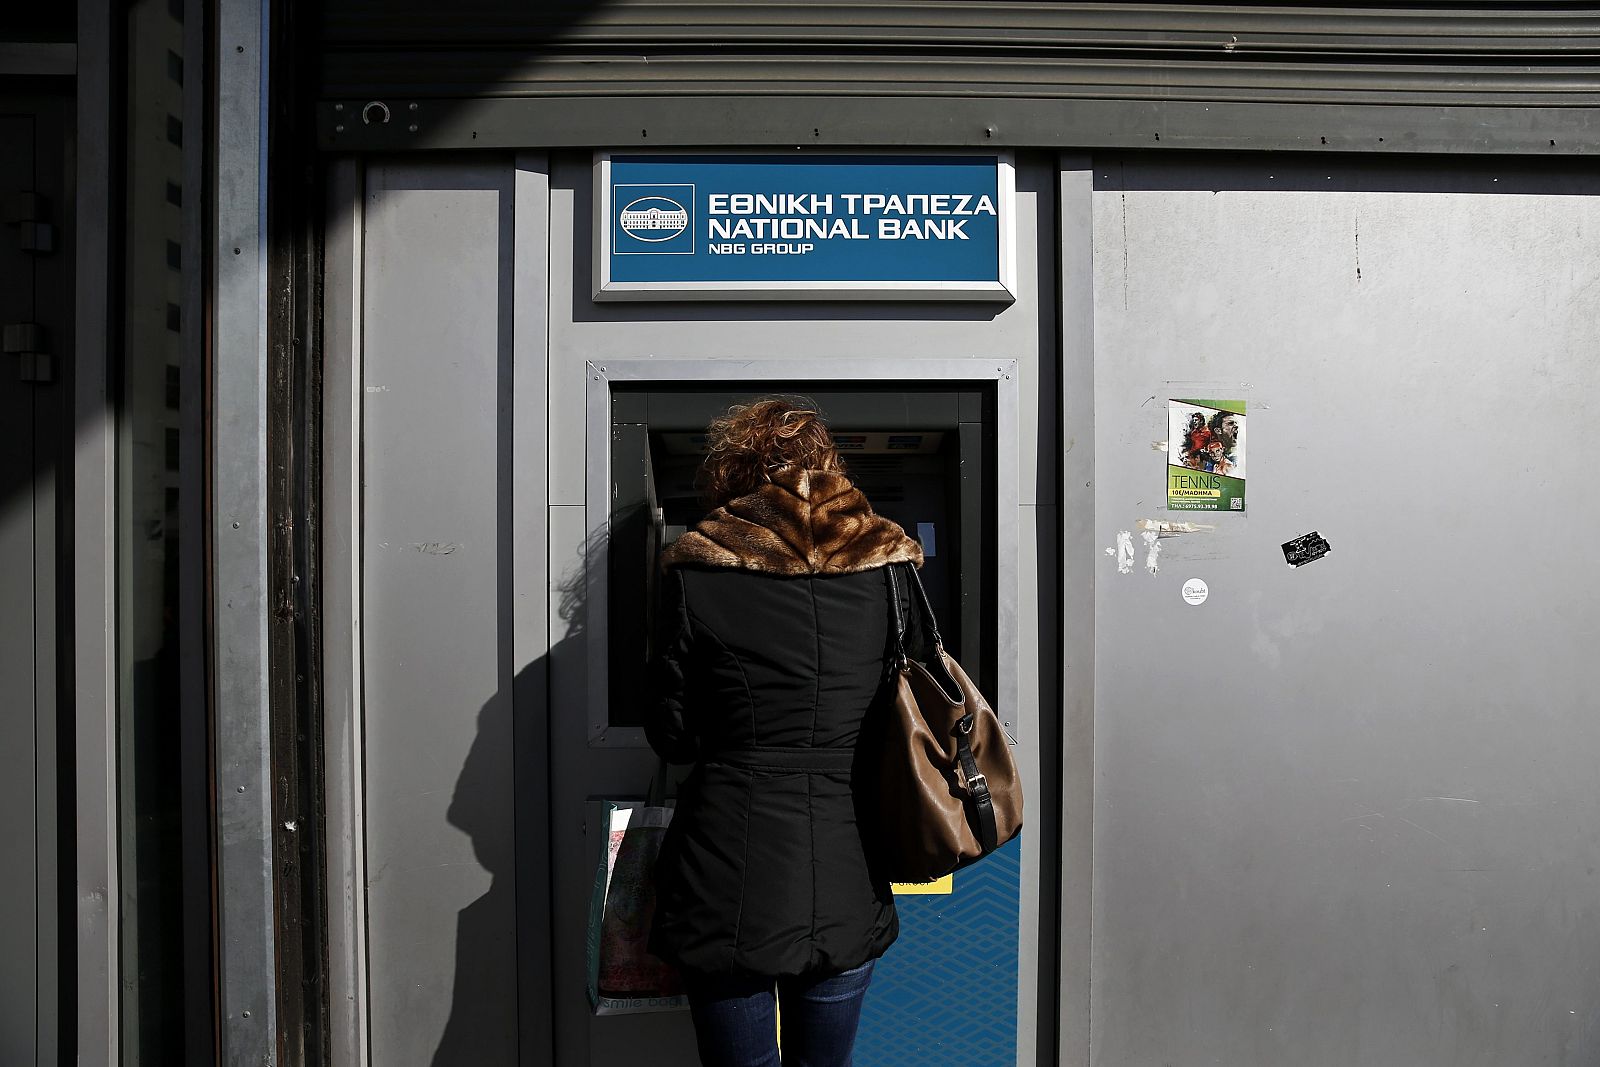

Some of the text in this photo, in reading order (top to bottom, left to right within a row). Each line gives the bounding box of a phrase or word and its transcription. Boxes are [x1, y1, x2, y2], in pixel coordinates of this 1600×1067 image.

[708, 193, 997, 216] ΕΘΝΙΚΗ ΤΡΑΠΕΖΑ
[708, 218, 970, 240] NATIONAL BANK
[708, 243, 814, 255] NBG GROUP
[1171, 475, 1221, 489] TENNIS
[603, 997, 642, 1009] smile
